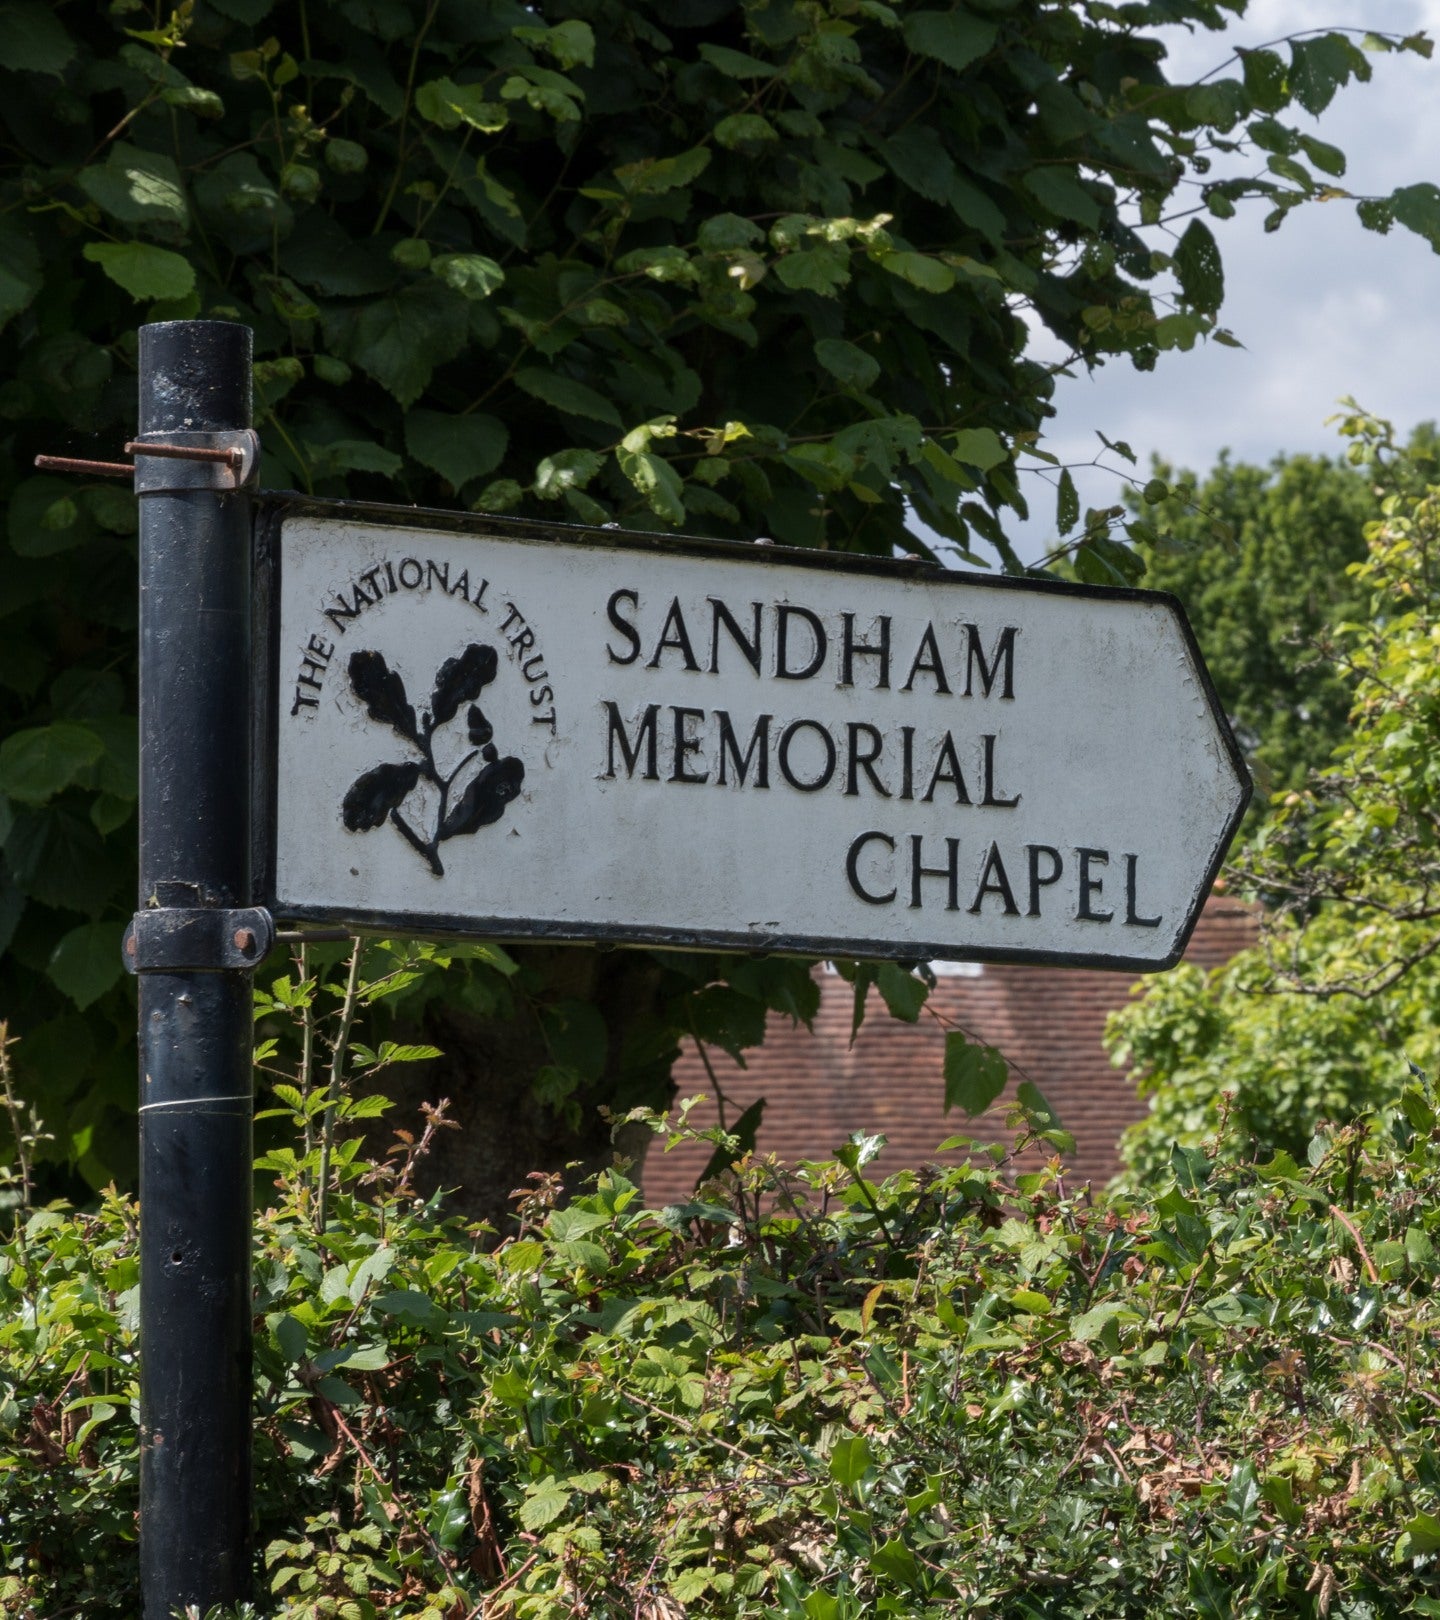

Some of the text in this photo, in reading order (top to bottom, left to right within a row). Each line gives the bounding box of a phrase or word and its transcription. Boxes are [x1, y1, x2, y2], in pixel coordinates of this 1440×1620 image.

[290, 557, 557, 737] THE NATIONAL TRUST
[605, 588, 1020, 702] SANDHAM
[601, 700, 1023, 810] MEMORIAL
[845, 830, 1164, 929] CHAPEL
